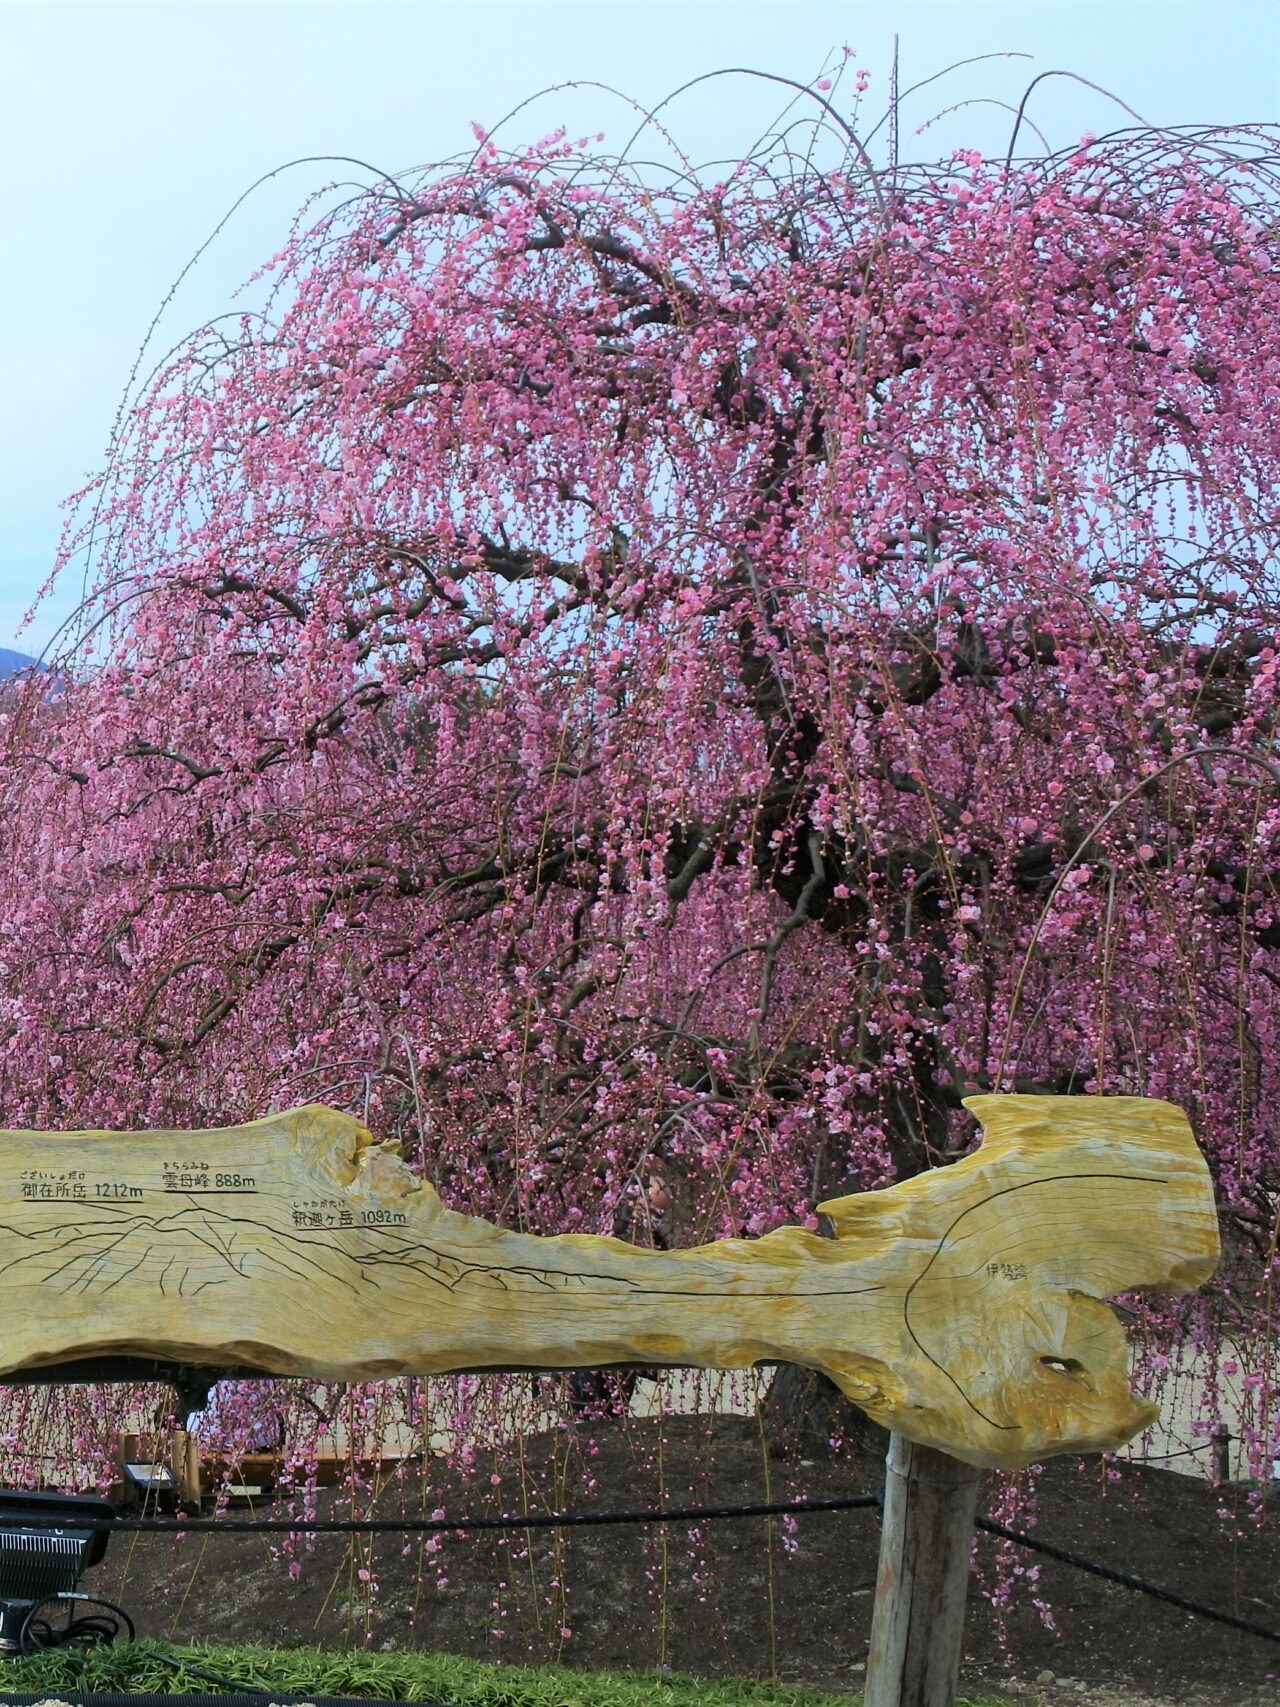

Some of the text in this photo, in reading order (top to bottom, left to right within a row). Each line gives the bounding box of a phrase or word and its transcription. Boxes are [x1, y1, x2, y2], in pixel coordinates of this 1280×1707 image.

[162, 1171, 256, 1189] 雲母峰 888m
[21, 1182, 144, 1199] 御在所岳 1212m
[361, 1209, 407, 1225] 1092m
